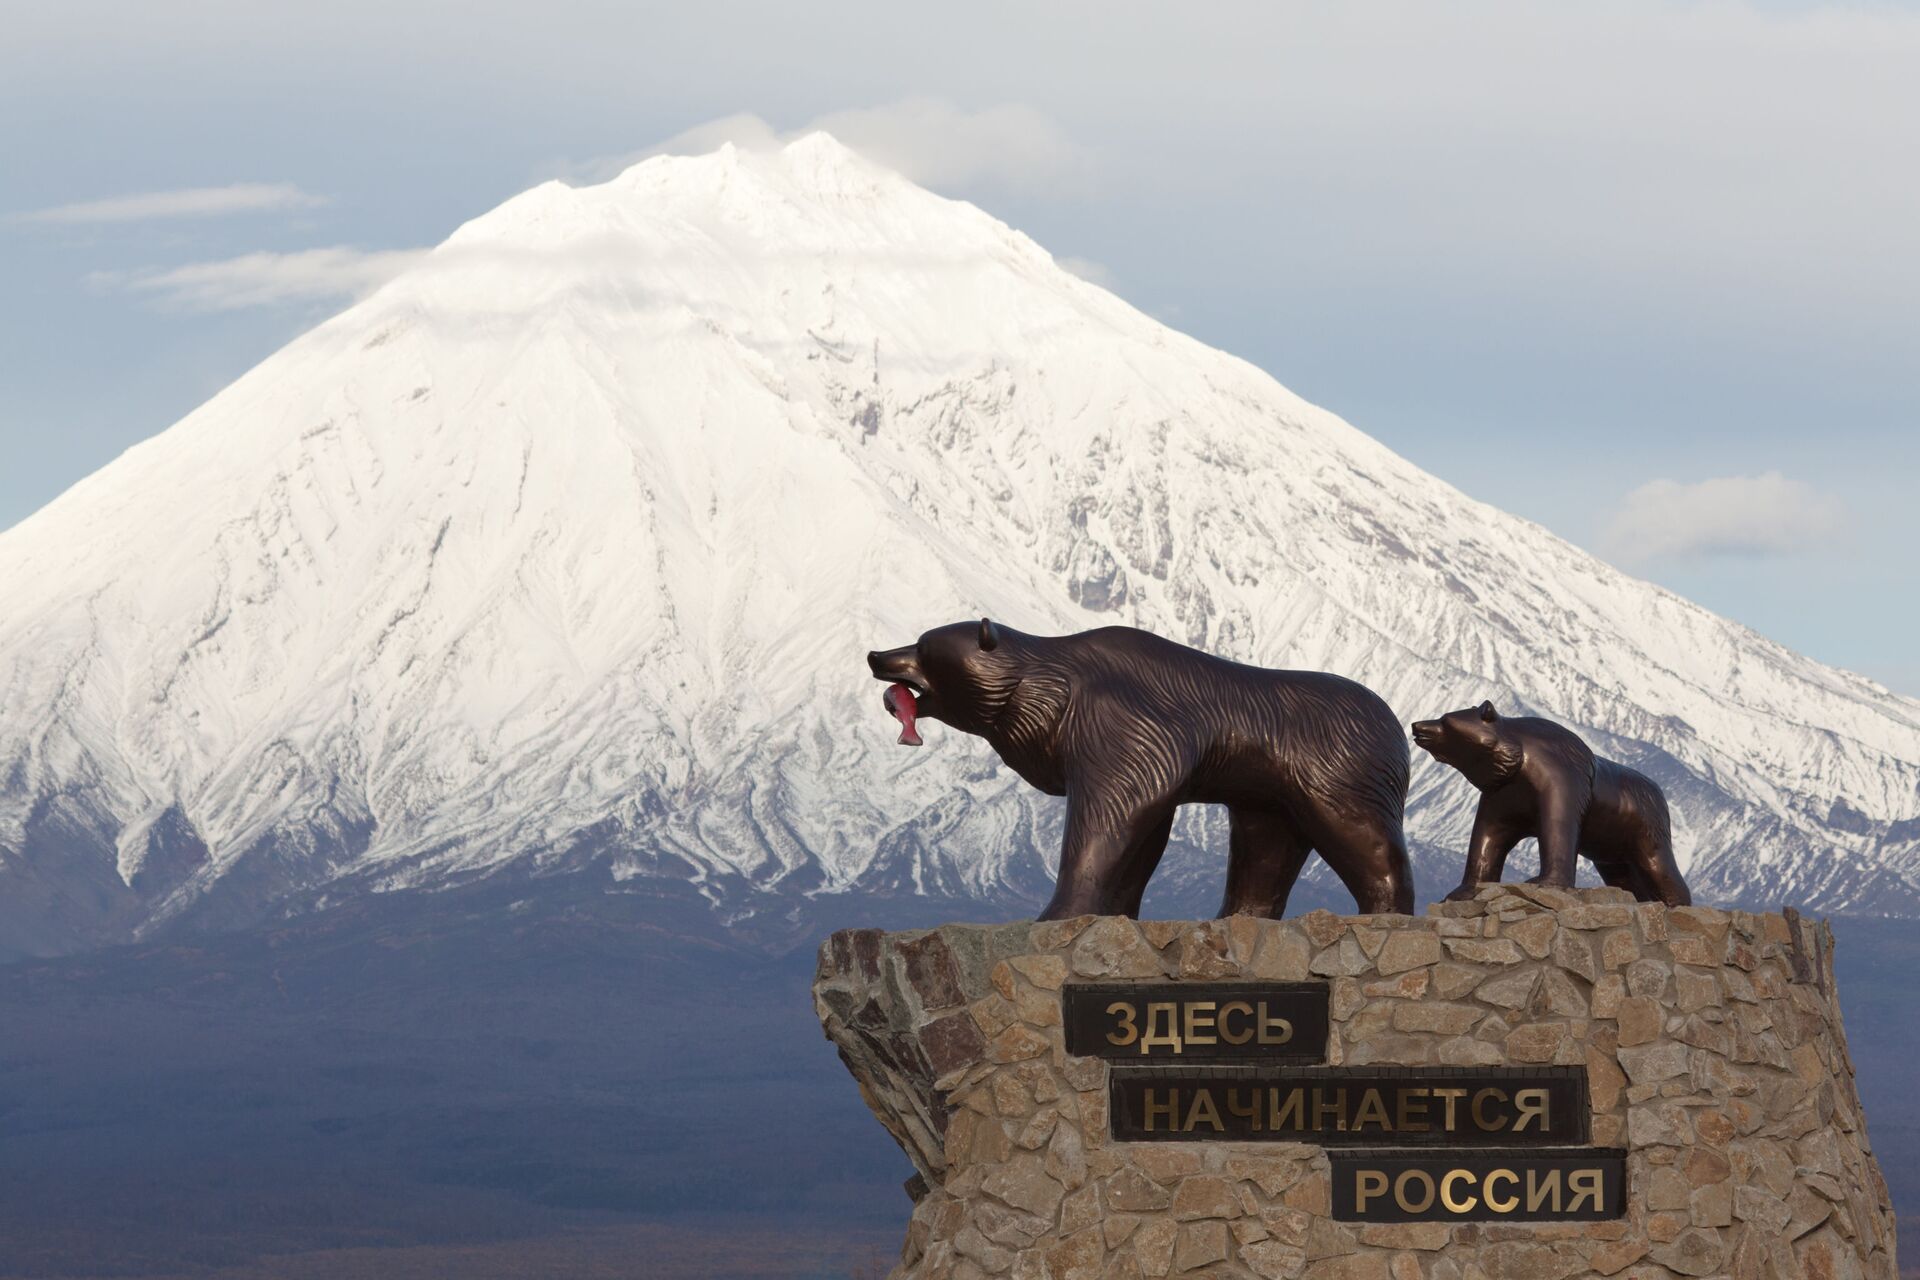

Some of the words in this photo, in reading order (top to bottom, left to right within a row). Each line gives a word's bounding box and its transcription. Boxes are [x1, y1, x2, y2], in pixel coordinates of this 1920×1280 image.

[1105, 1001, 1294, 1054] ЗДЕСЬ
[1143, 1087, 1550, 1132] НАЧИНАЕТСЯ
[1355, 1168, 1604, 1213] РОССИЯ
